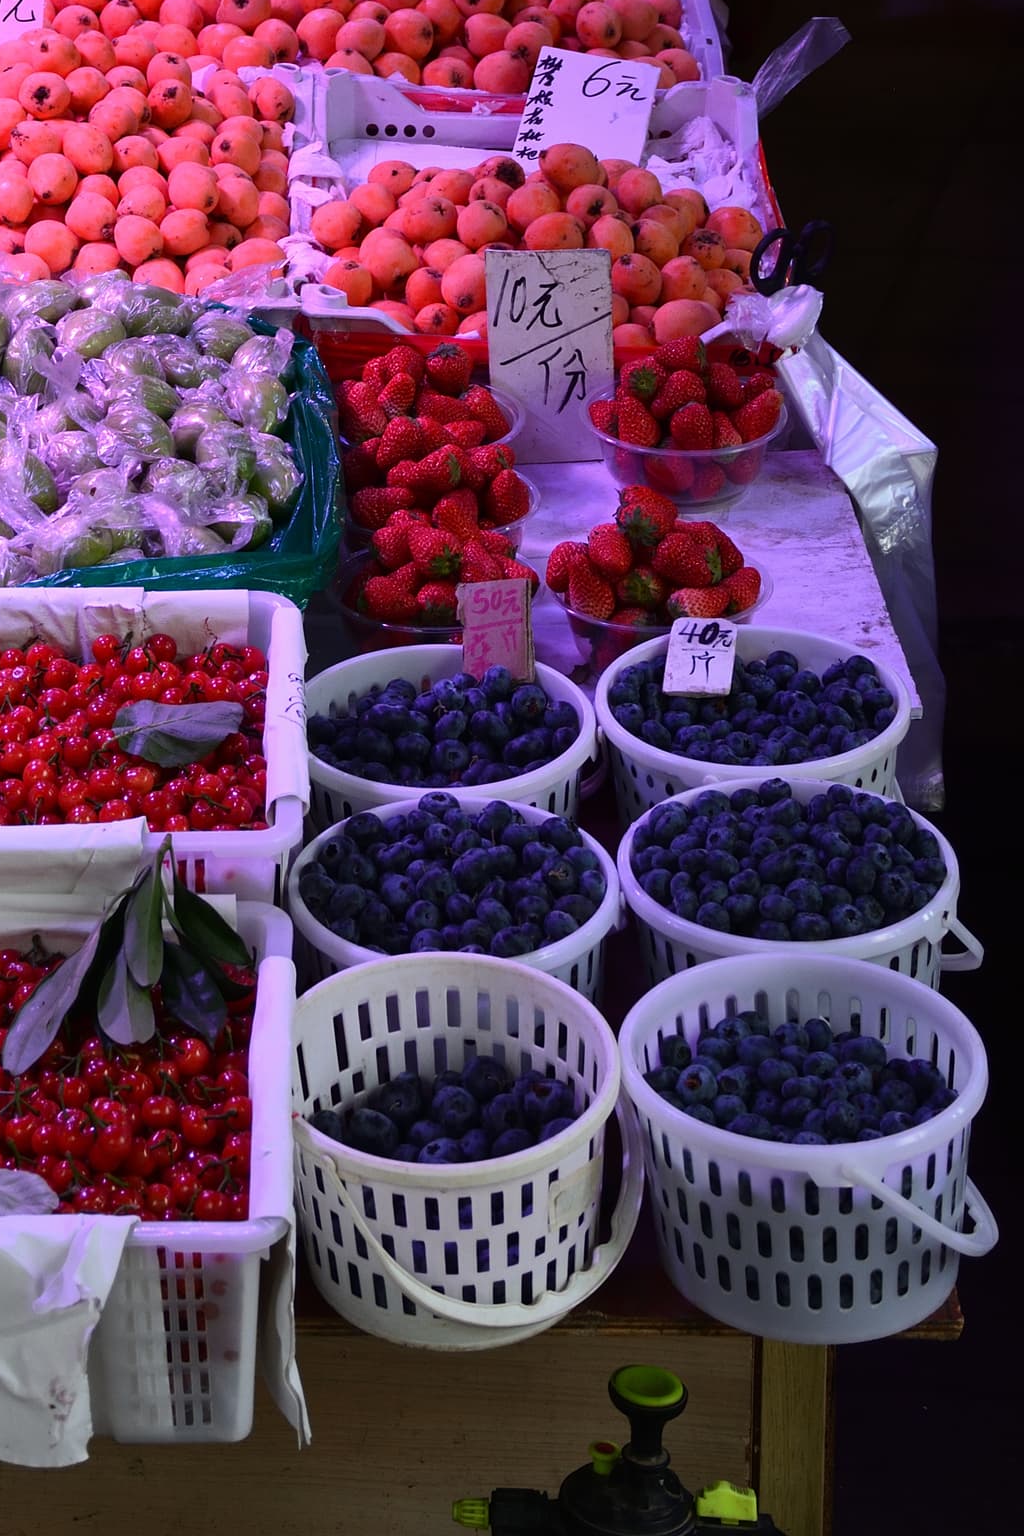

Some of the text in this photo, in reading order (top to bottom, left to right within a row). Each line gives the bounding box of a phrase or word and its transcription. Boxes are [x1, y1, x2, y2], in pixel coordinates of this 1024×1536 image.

[582, 60, 648, 101] 6元
[492, 268, 563, 331] 10元
[471, 588, 521, 616] 50元
[678, 620, 734, 649] 40元
